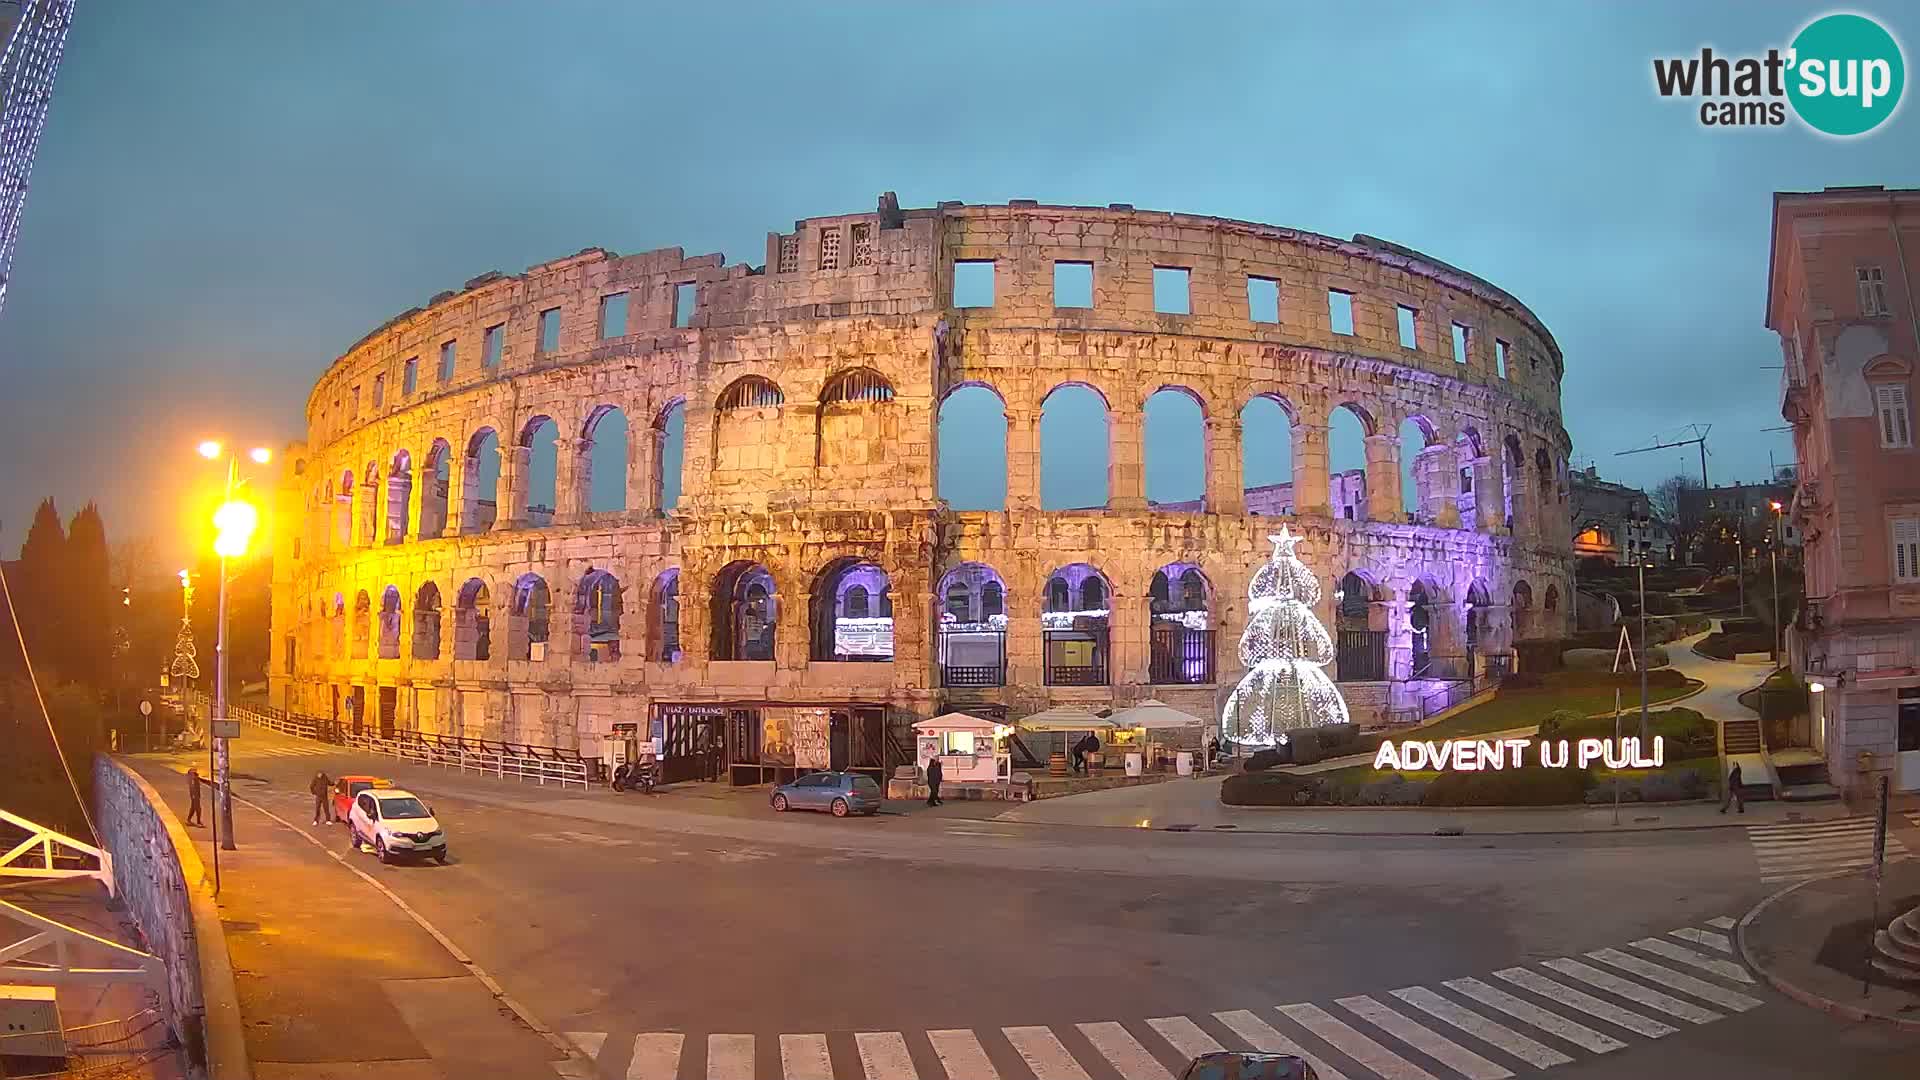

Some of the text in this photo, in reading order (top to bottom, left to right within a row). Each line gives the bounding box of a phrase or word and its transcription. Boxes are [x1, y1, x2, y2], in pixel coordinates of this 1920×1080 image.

[689, 707, 724, 715] ENTRANCE
[1373, 736, 1664, 771] ADVENT U PULI
